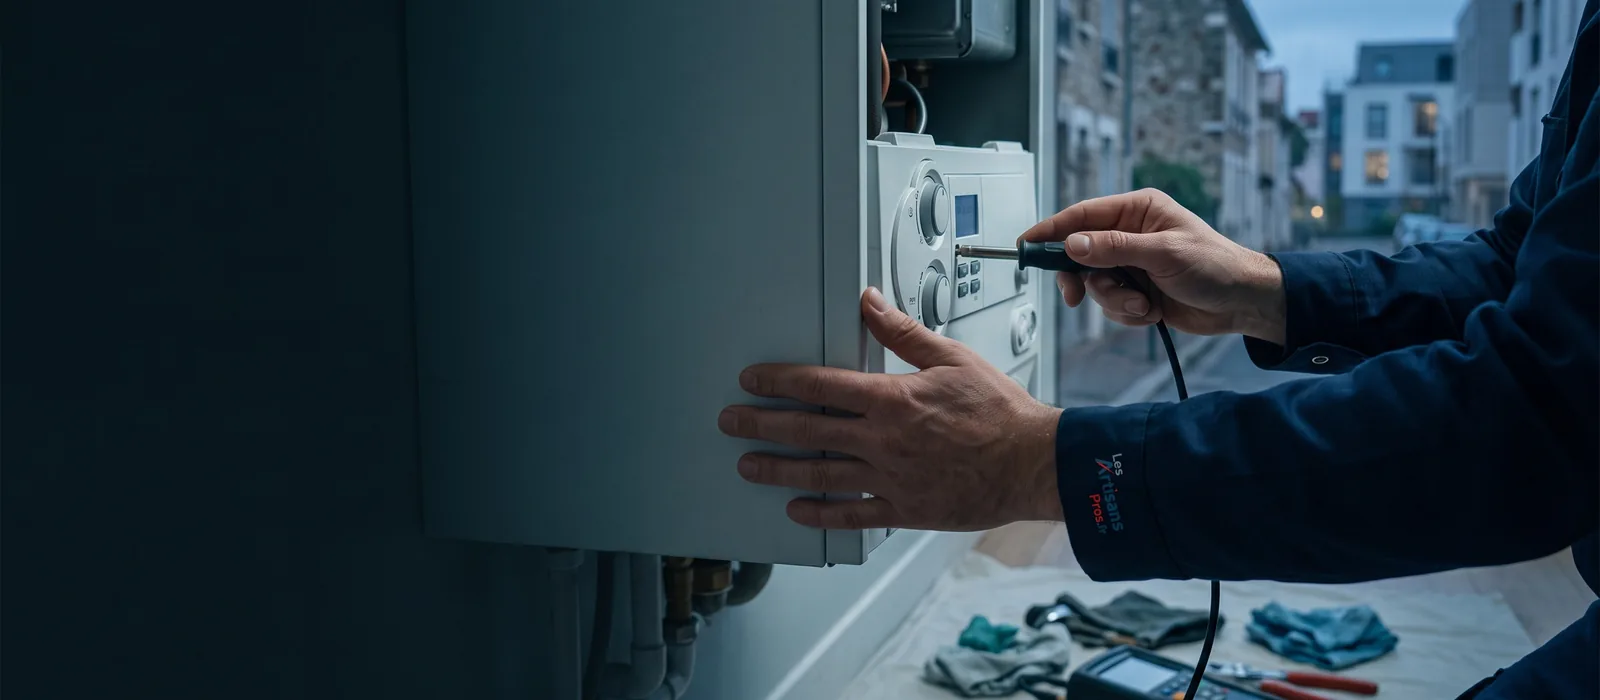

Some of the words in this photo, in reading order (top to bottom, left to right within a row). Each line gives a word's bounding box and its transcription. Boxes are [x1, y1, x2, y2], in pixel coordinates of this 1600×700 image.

[1112, 453, 1123, 476] Les
[1089, 493, 1108, 534] Pros.fr
[1094, 457, 1124, 532] Artisans
